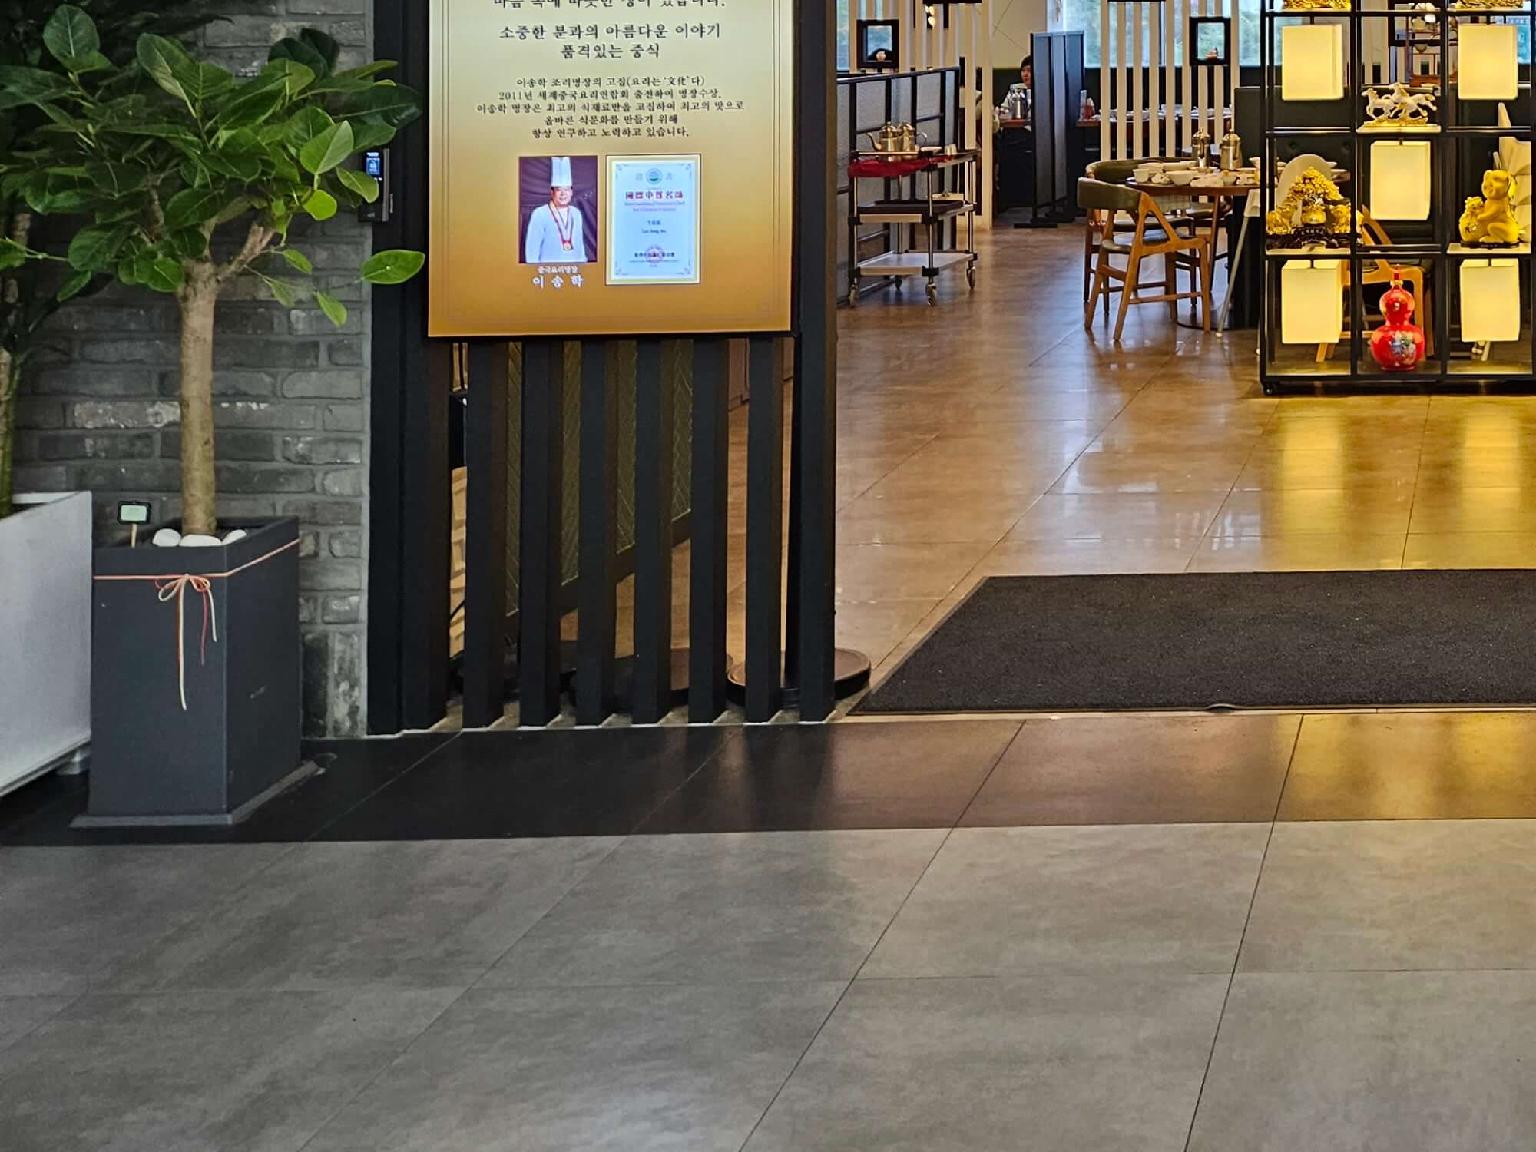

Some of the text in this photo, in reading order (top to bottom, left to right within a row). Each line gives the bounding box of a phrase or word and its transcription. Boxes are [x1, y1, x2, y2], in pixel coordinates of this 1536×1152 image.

[500, 23, 547, 40] 소중한
[606, 23, 668, 40] 아름다운
[675, 23, 720, 40] 이야기
[561, 44, 660, 59] 품격있는 중식
